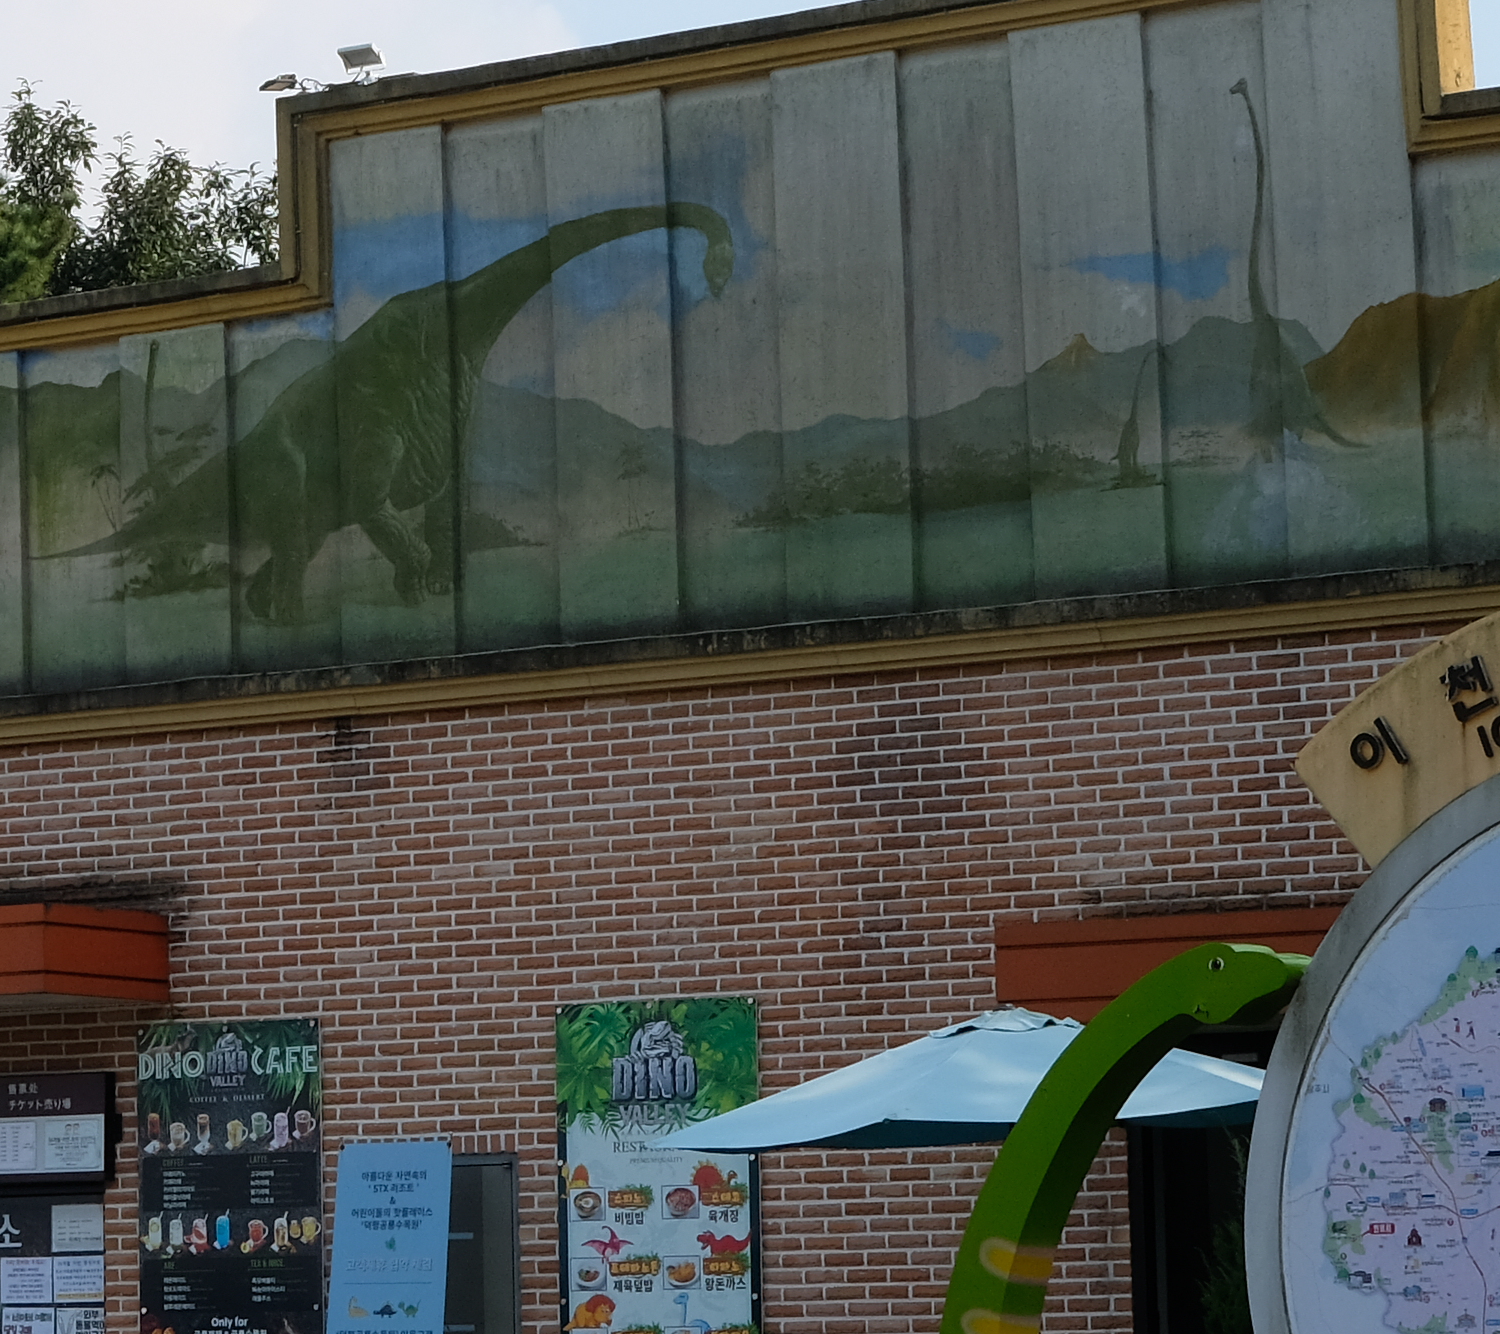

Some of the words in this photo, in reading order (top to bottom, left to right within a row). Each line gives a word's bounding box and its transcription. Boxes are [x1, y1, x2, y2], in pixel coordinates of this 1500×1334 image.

[138, 1050, 205, 1081] DINO
[251, 1045, 318, 1075] CAFE
[206, 1050, 248, 1074] DINO
[209, 1074, 247, 1087] VALLEY
[611, 1055, 698, 1101] DINO
[619, 1103, 691, 1125] VALLEY
[361, 1170, 393, 1182] 아름다운
[395, 1169, 427, 1181] 자연속의
[373, 1184, 389, 1193] STX
[390, 1183, 414, 1193] 리조트
[351, 1207, 391, 1219] 어린이들의
[614, 1211, 644, 1225] 비빔밥
[708, 1209, 739, 1223] 육개장
[613, 1279, 653, 1293] 제육덮밥
[704, 1277, 747, 1292] 왕돈까스
[211, 1316, 233, 1329] Only
[234, 1315, 249, 1327] for
